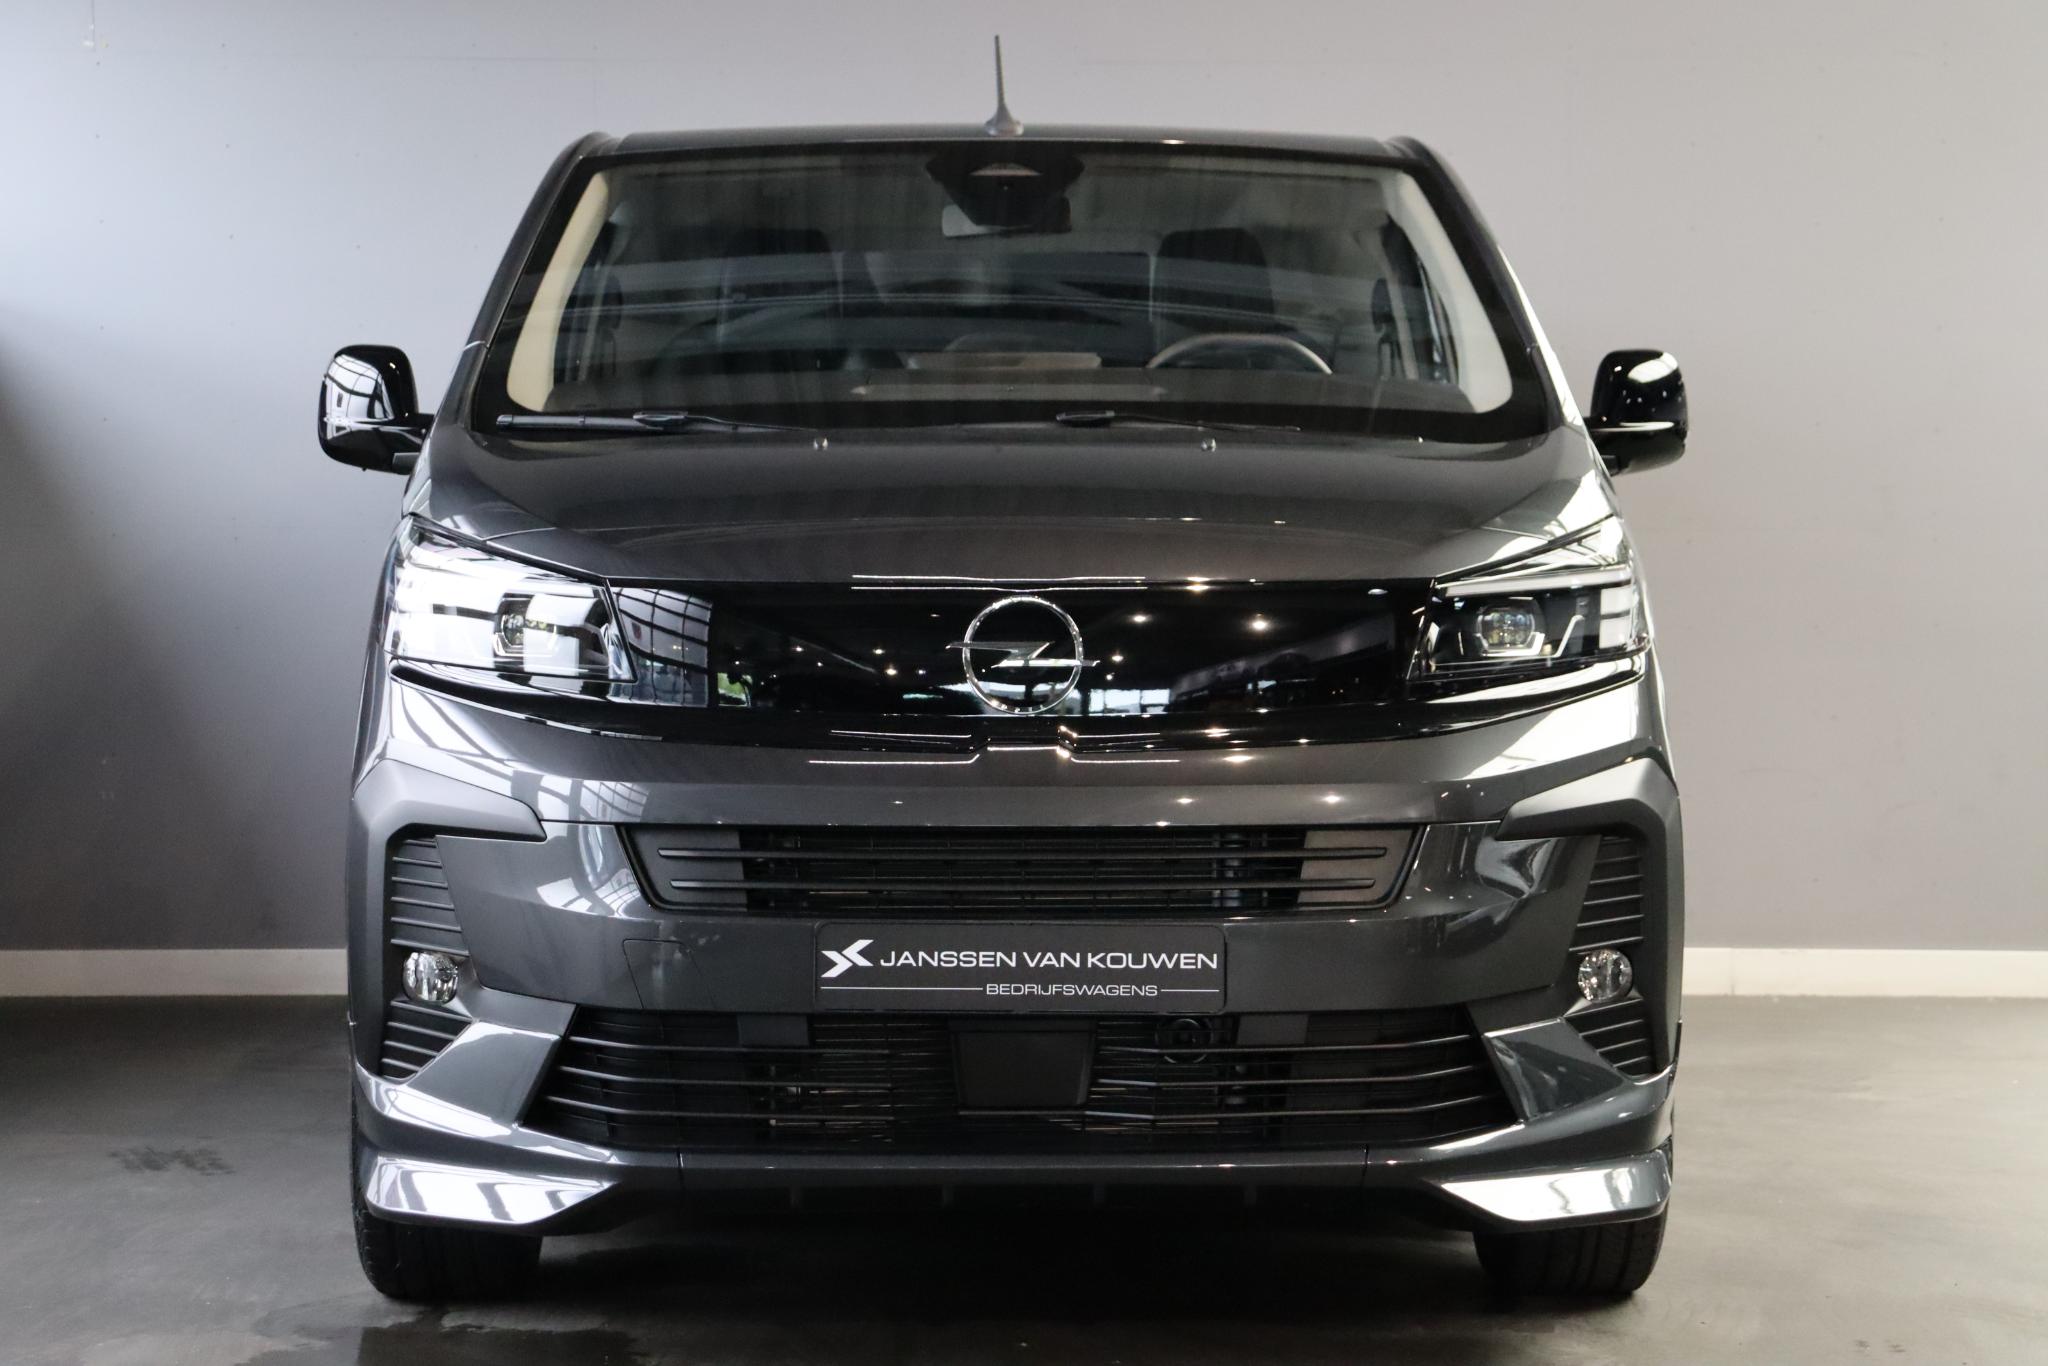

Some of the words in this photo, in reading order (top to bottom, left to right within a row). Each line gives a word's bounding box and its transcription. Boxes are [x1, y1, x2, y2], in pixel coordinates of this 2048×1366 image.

[879, 950, 1017, 968] JANSSEN
[1022, 951, 1081, 968] VAN
[1086, 952, 1218, 969] KOUWEN
[985, 983, 1158, 997] BEDRIJFSWAGENS
